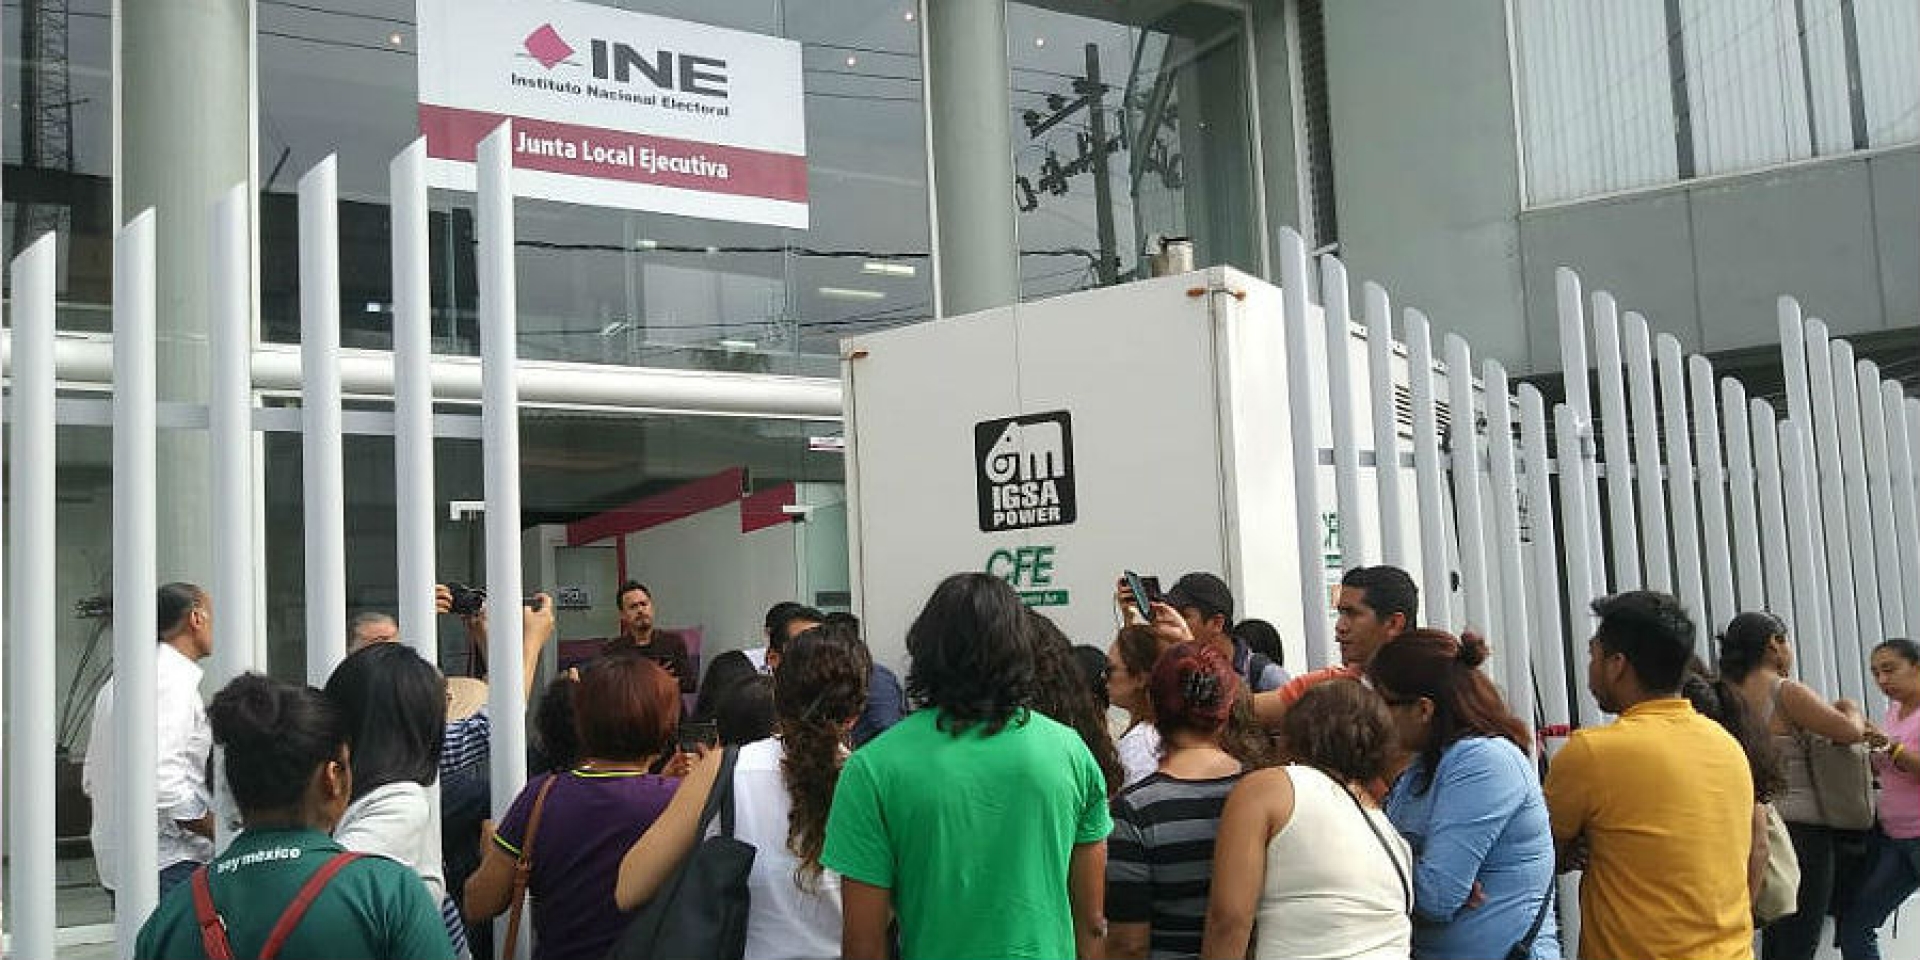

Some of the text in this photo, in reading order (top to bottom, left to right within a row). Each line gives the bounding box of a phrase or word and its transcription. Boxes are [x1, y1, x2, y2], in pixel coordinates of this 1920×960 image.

[590, 38, 729, 99] INE
[511, 72, 729, 116] Instituto Nacional Electoral
[516, 131, 729, 179] Junta Local Ejecutiva
[991, 479, 1061, 511] IGSA
[992, 507, 1062, 528] POWER
[985, 546, 1056, 586] CFE
